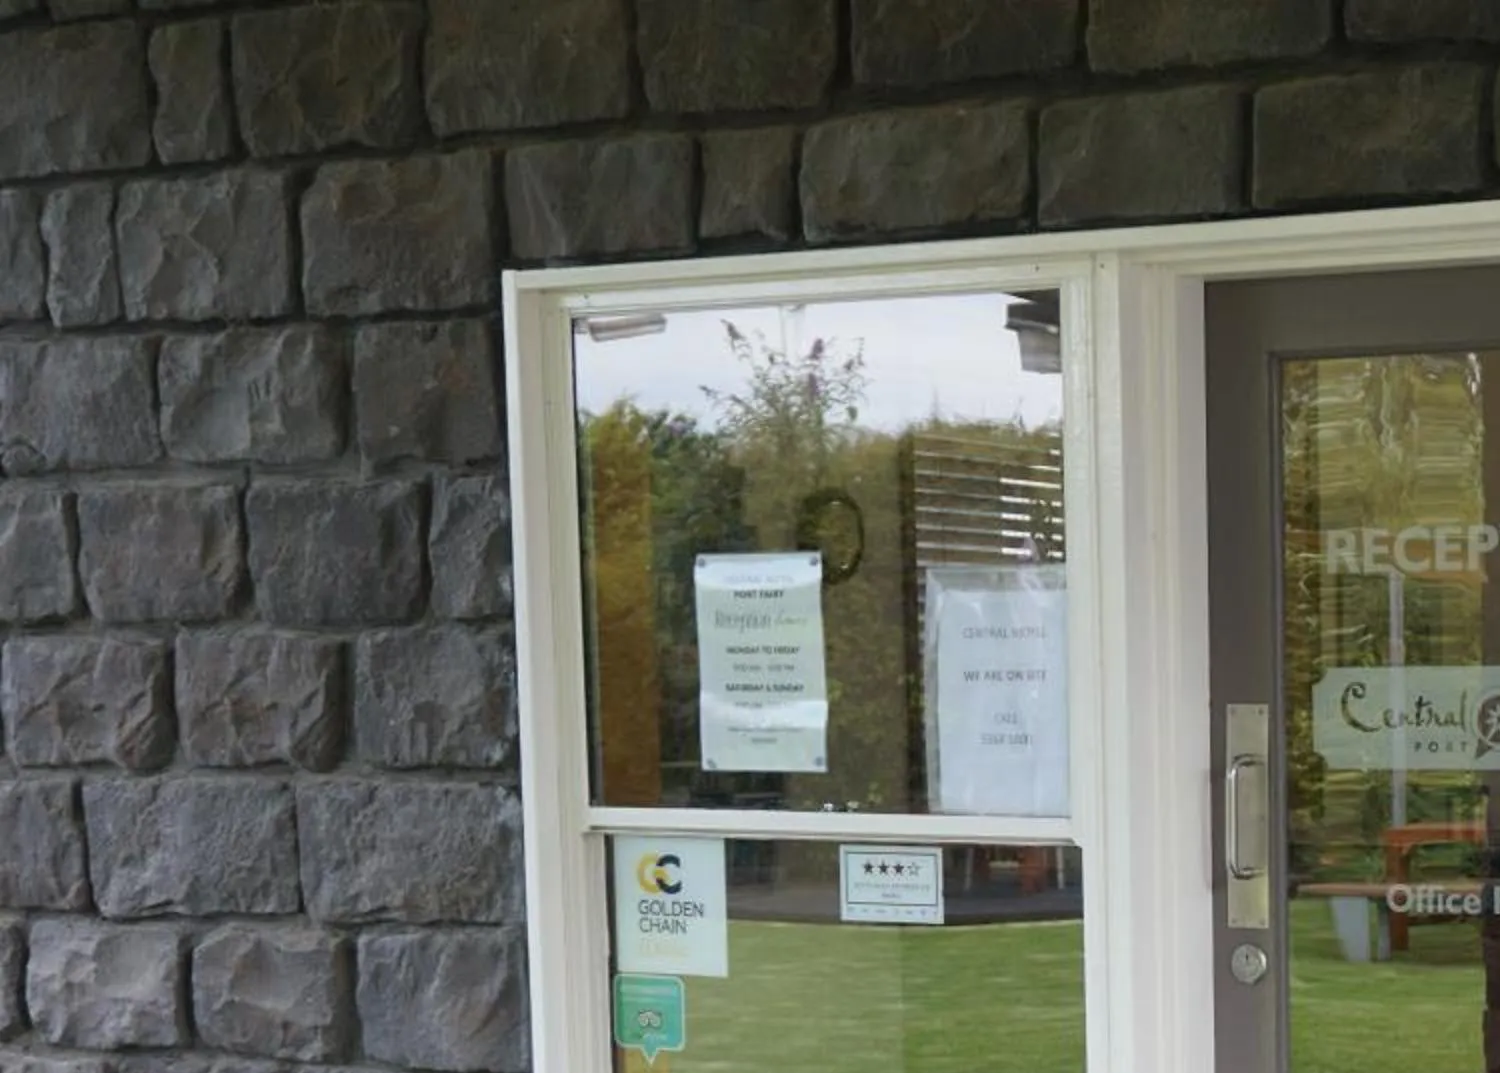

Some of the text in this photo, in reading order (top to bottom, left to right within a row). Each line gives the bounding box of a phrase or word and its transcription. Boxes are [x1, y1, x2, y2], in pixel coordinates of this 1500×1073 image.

[1340, 681, 1468, 733] Central
[1415, 740, 1469, 753] PORT
[1387, 883, 1482, 914] Office
[638, 900, 704, 918] GOLDEN
[638, 917, 688, 935] CHAIN
